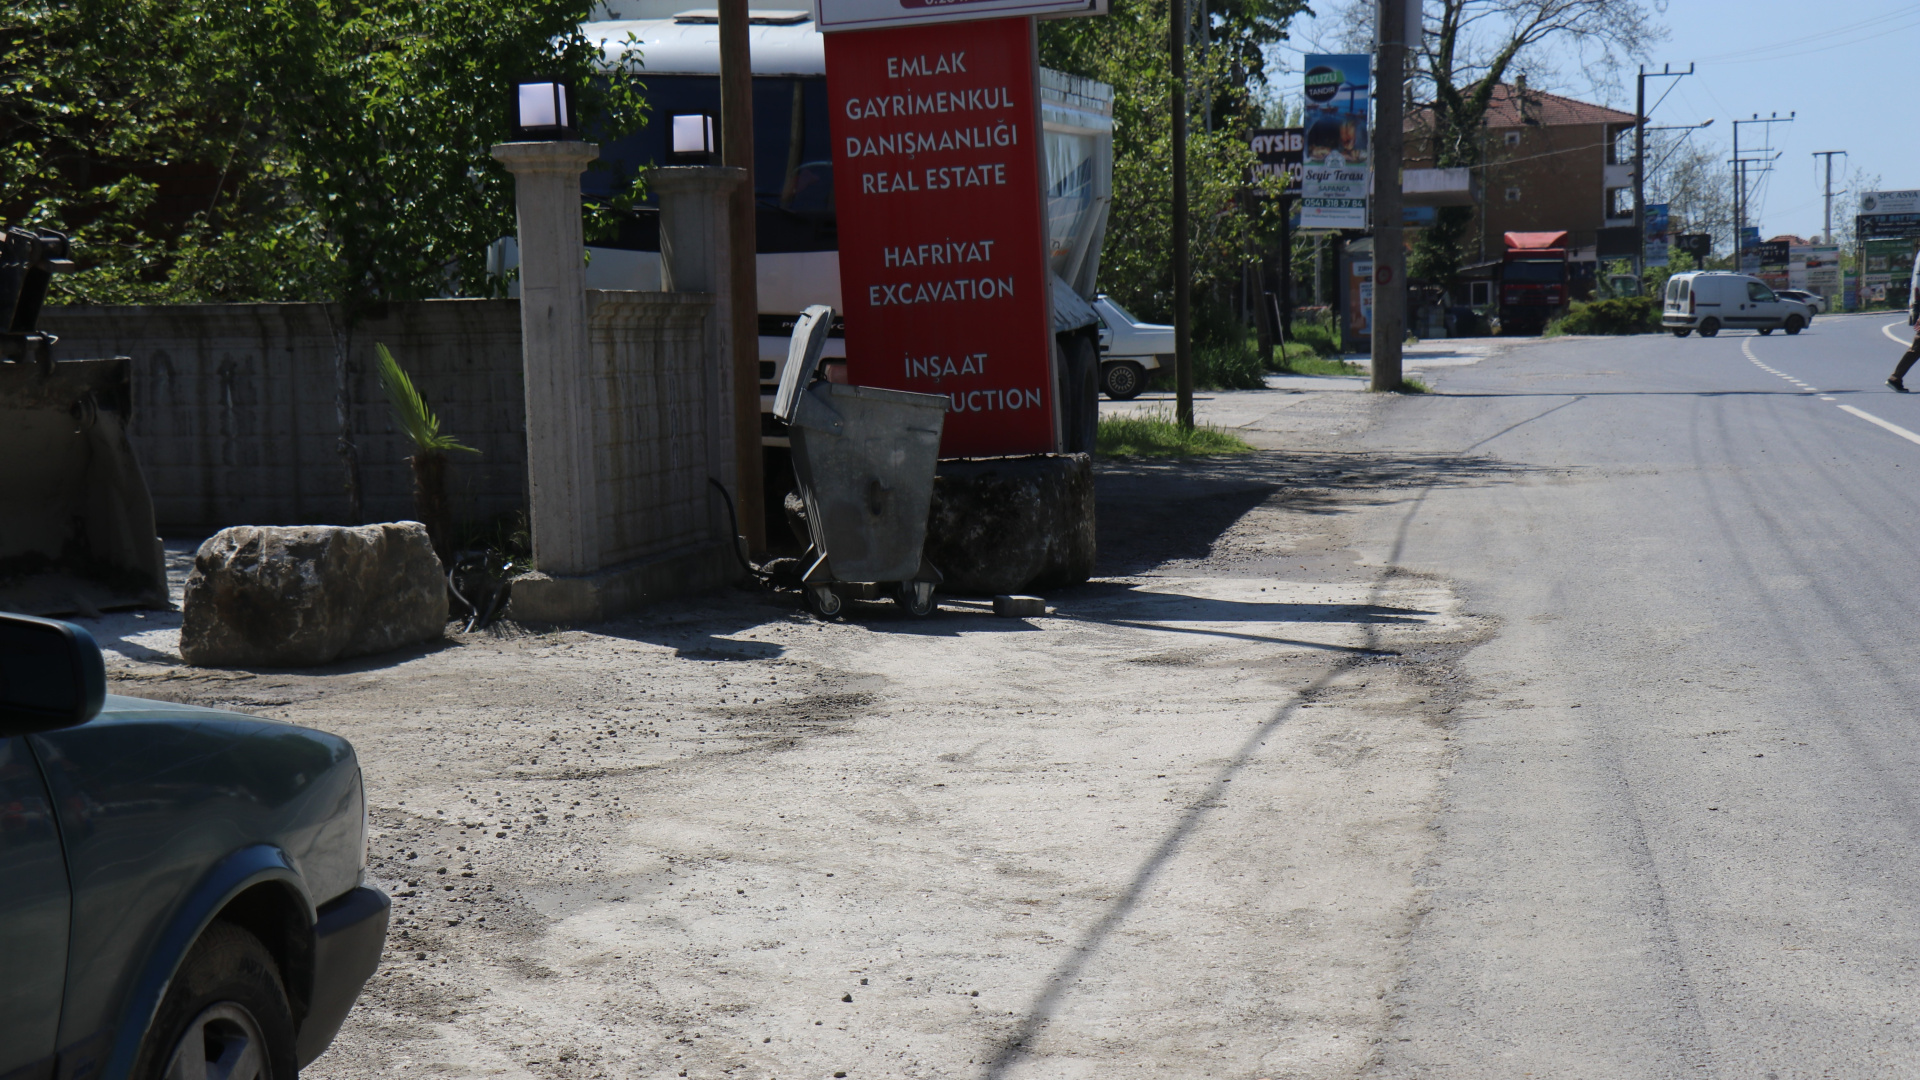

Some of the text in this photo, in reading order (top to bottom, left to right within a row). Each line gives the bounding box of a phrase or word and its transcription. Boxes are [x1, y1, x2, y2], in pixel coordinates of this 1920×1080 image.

[887, 51, 966, 78] EMLAK
[1309, 72, 1337, 85] KUZU
[846, 87, 1014, 120] GAYRİMENKUL
[1308, 86, 1336, 96] TANDIR
[846, 119, 1018, 159] DANIŞMANLIĞI
[862, 164, 1006, 194] REAL ESTATE
[1305, 170, 1364, 184] Seyir Terası
[1304, 199, 1363, 207] 0541 318 37 84
[884, 237, 994, 268] HAFRİYAT
[869, 277, 1014, 306] EXCAVATION
[904, 352, 988, 383] İNŞAAT
[945, 387, 1041, 413] UCTION
